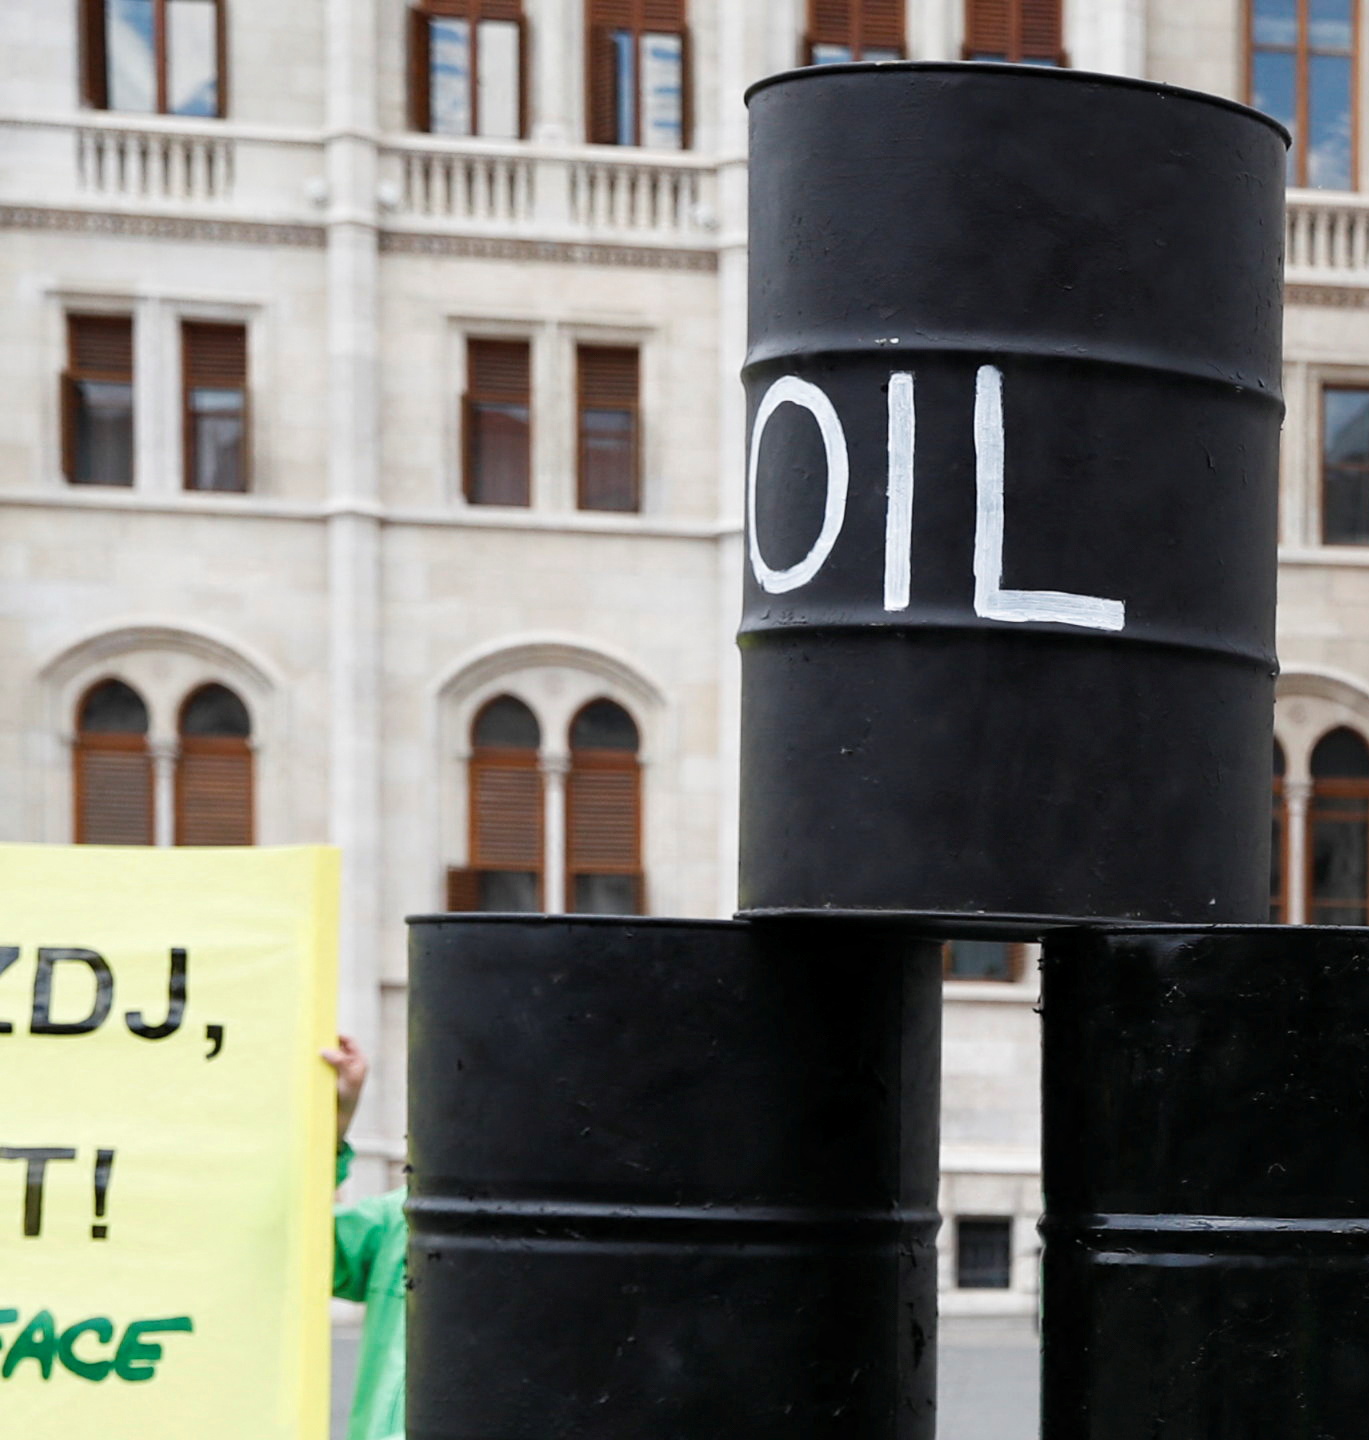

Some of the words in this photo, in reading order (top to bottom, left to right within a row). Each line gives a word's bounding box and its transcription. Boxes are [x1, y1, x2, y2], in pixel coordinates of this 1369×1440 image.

[748, 365, 1125, 631] OIL
[0, 946, 224, 1060] DJ,
[0, 1308, 194, 1382] ACE
